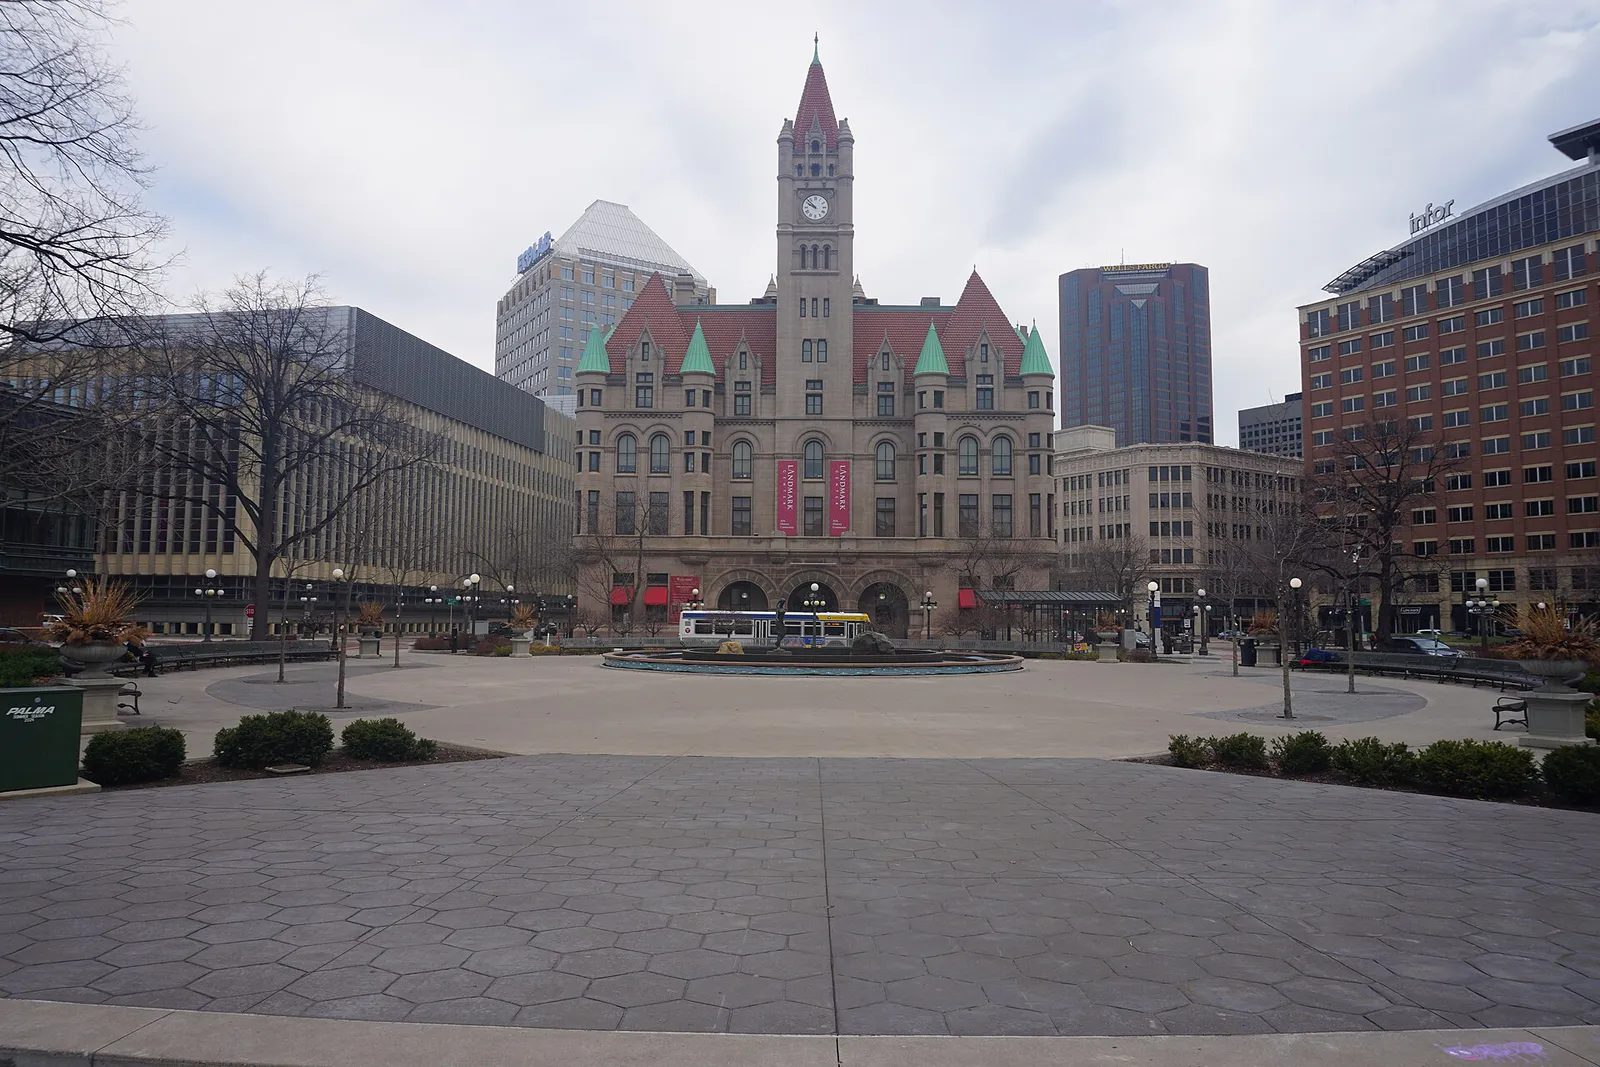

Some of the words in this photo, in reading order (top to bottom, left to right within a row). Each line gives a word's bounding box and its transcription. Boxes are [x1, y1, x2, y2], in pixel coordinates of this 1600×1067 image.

[1408, 198, 1455, 235] infor
[839, 465, 847, 510] LANDMARK
[6, 706, 55, 715] PALMA
